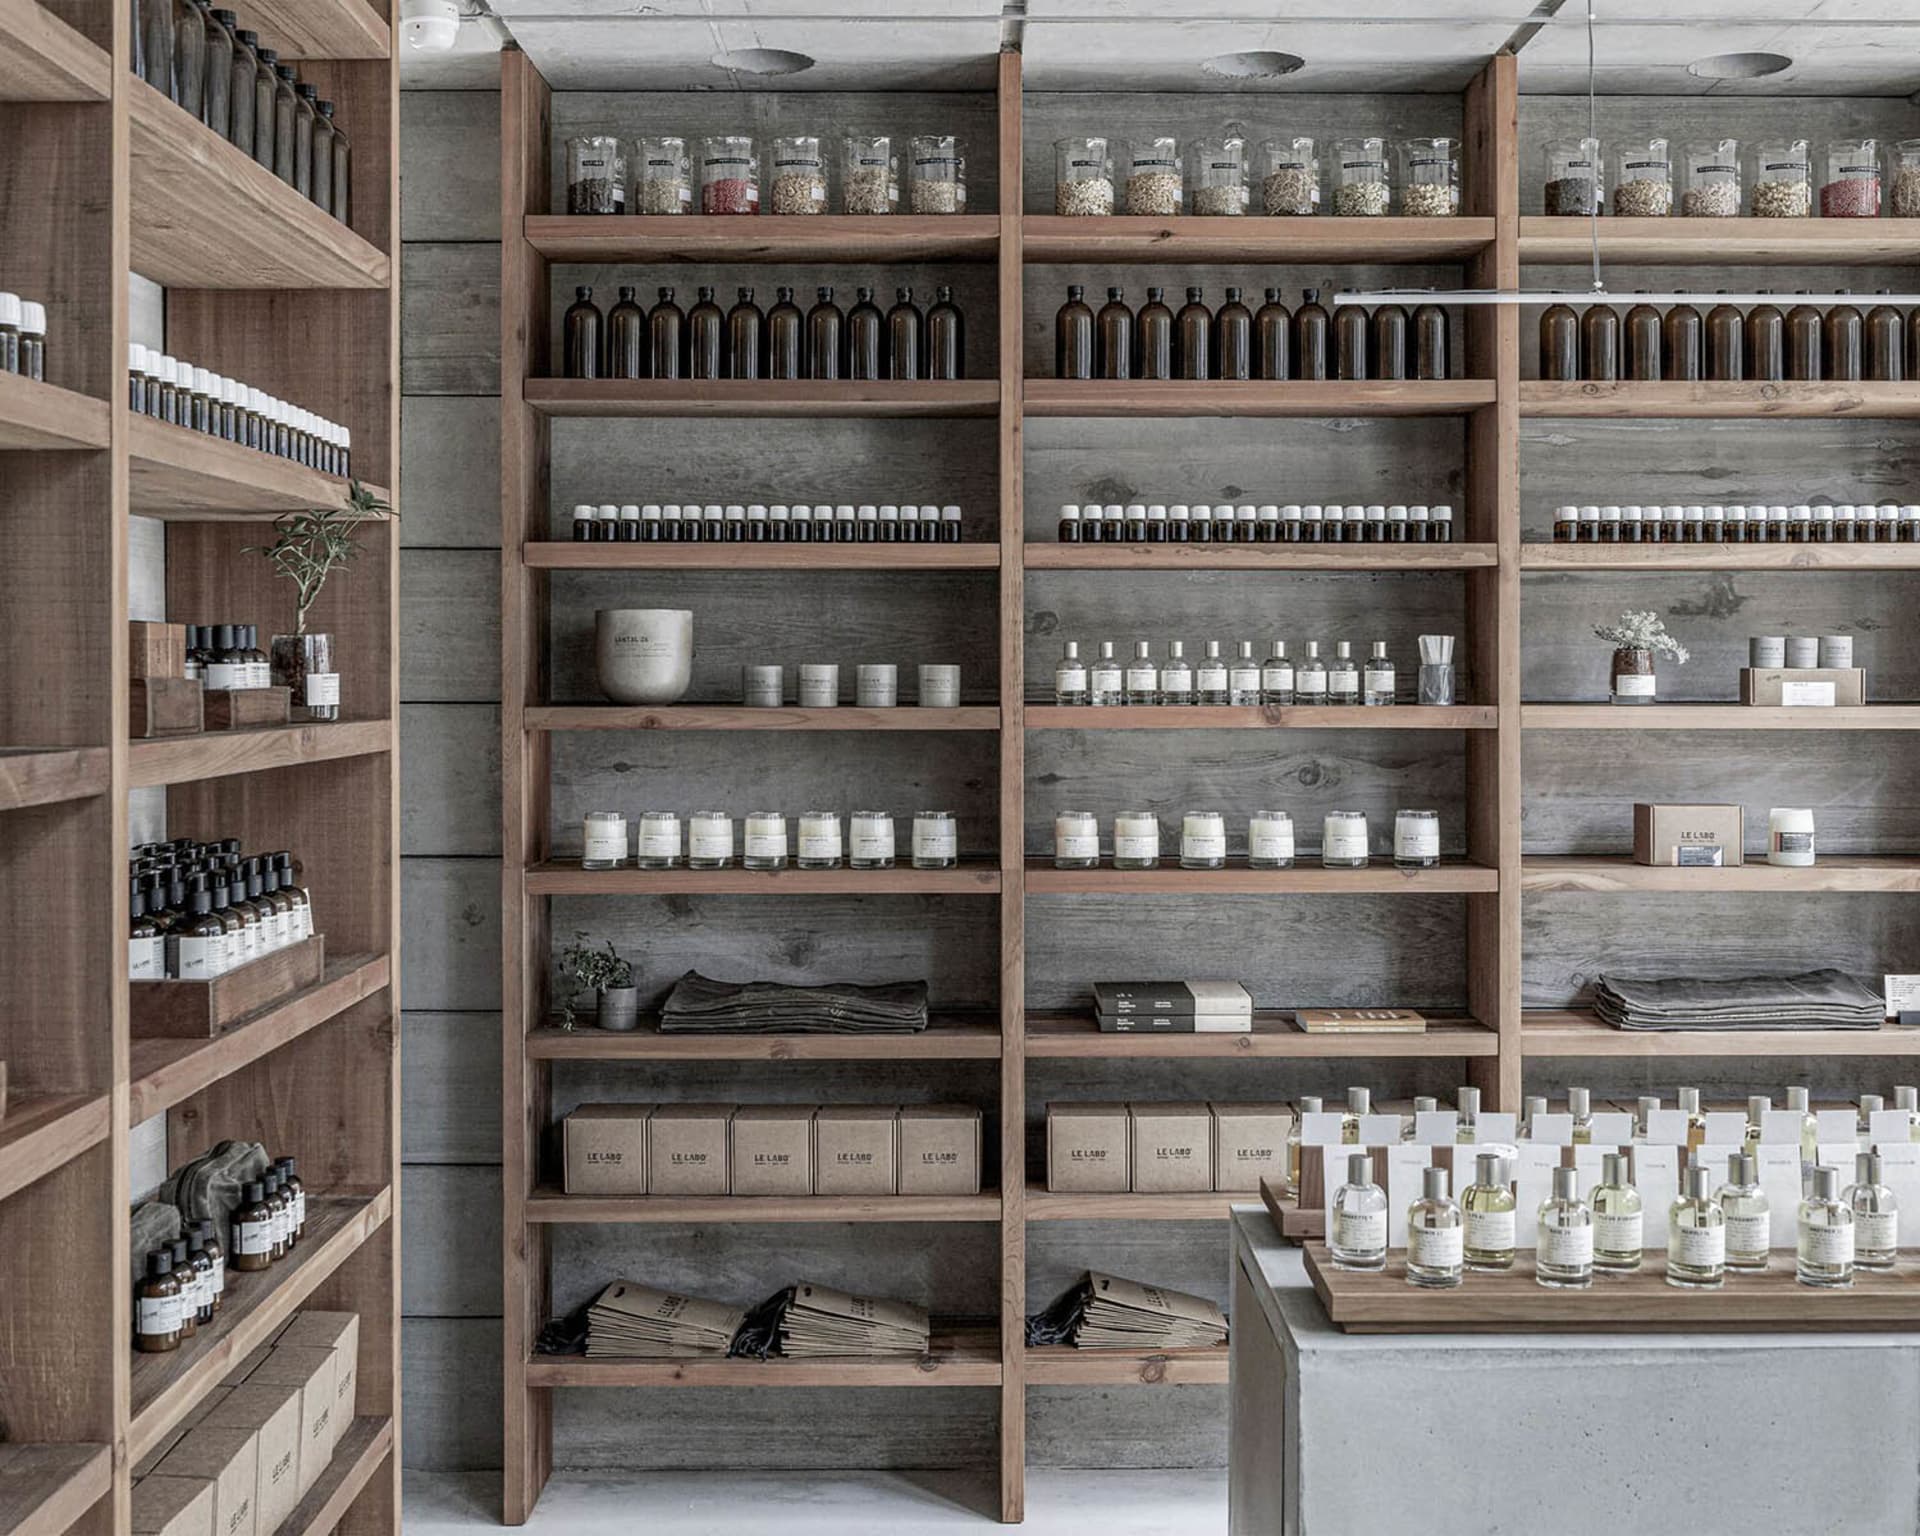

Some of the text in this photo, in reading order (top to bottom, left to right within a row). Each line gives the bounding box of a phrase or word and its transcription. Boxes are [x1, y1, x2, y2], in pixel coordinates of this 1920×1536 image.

[1681, 831, 1716, 840] LE LABO
[1071, 1148, 1106, 1158] LE LABO
[1156, 1146, 1192, 1156] LE LABO
[1237, 1148, 1272, 1157] LE LABO
[587, 1152, 622, 1161] LE LABO
[671, 1152, 706, 1162] LE LABO
[754, 1153, 789, 1162] LE LABO
[837, 1152, 872, 1161] LE LABO
[922, 1152, 957, 1161] LE LABO
